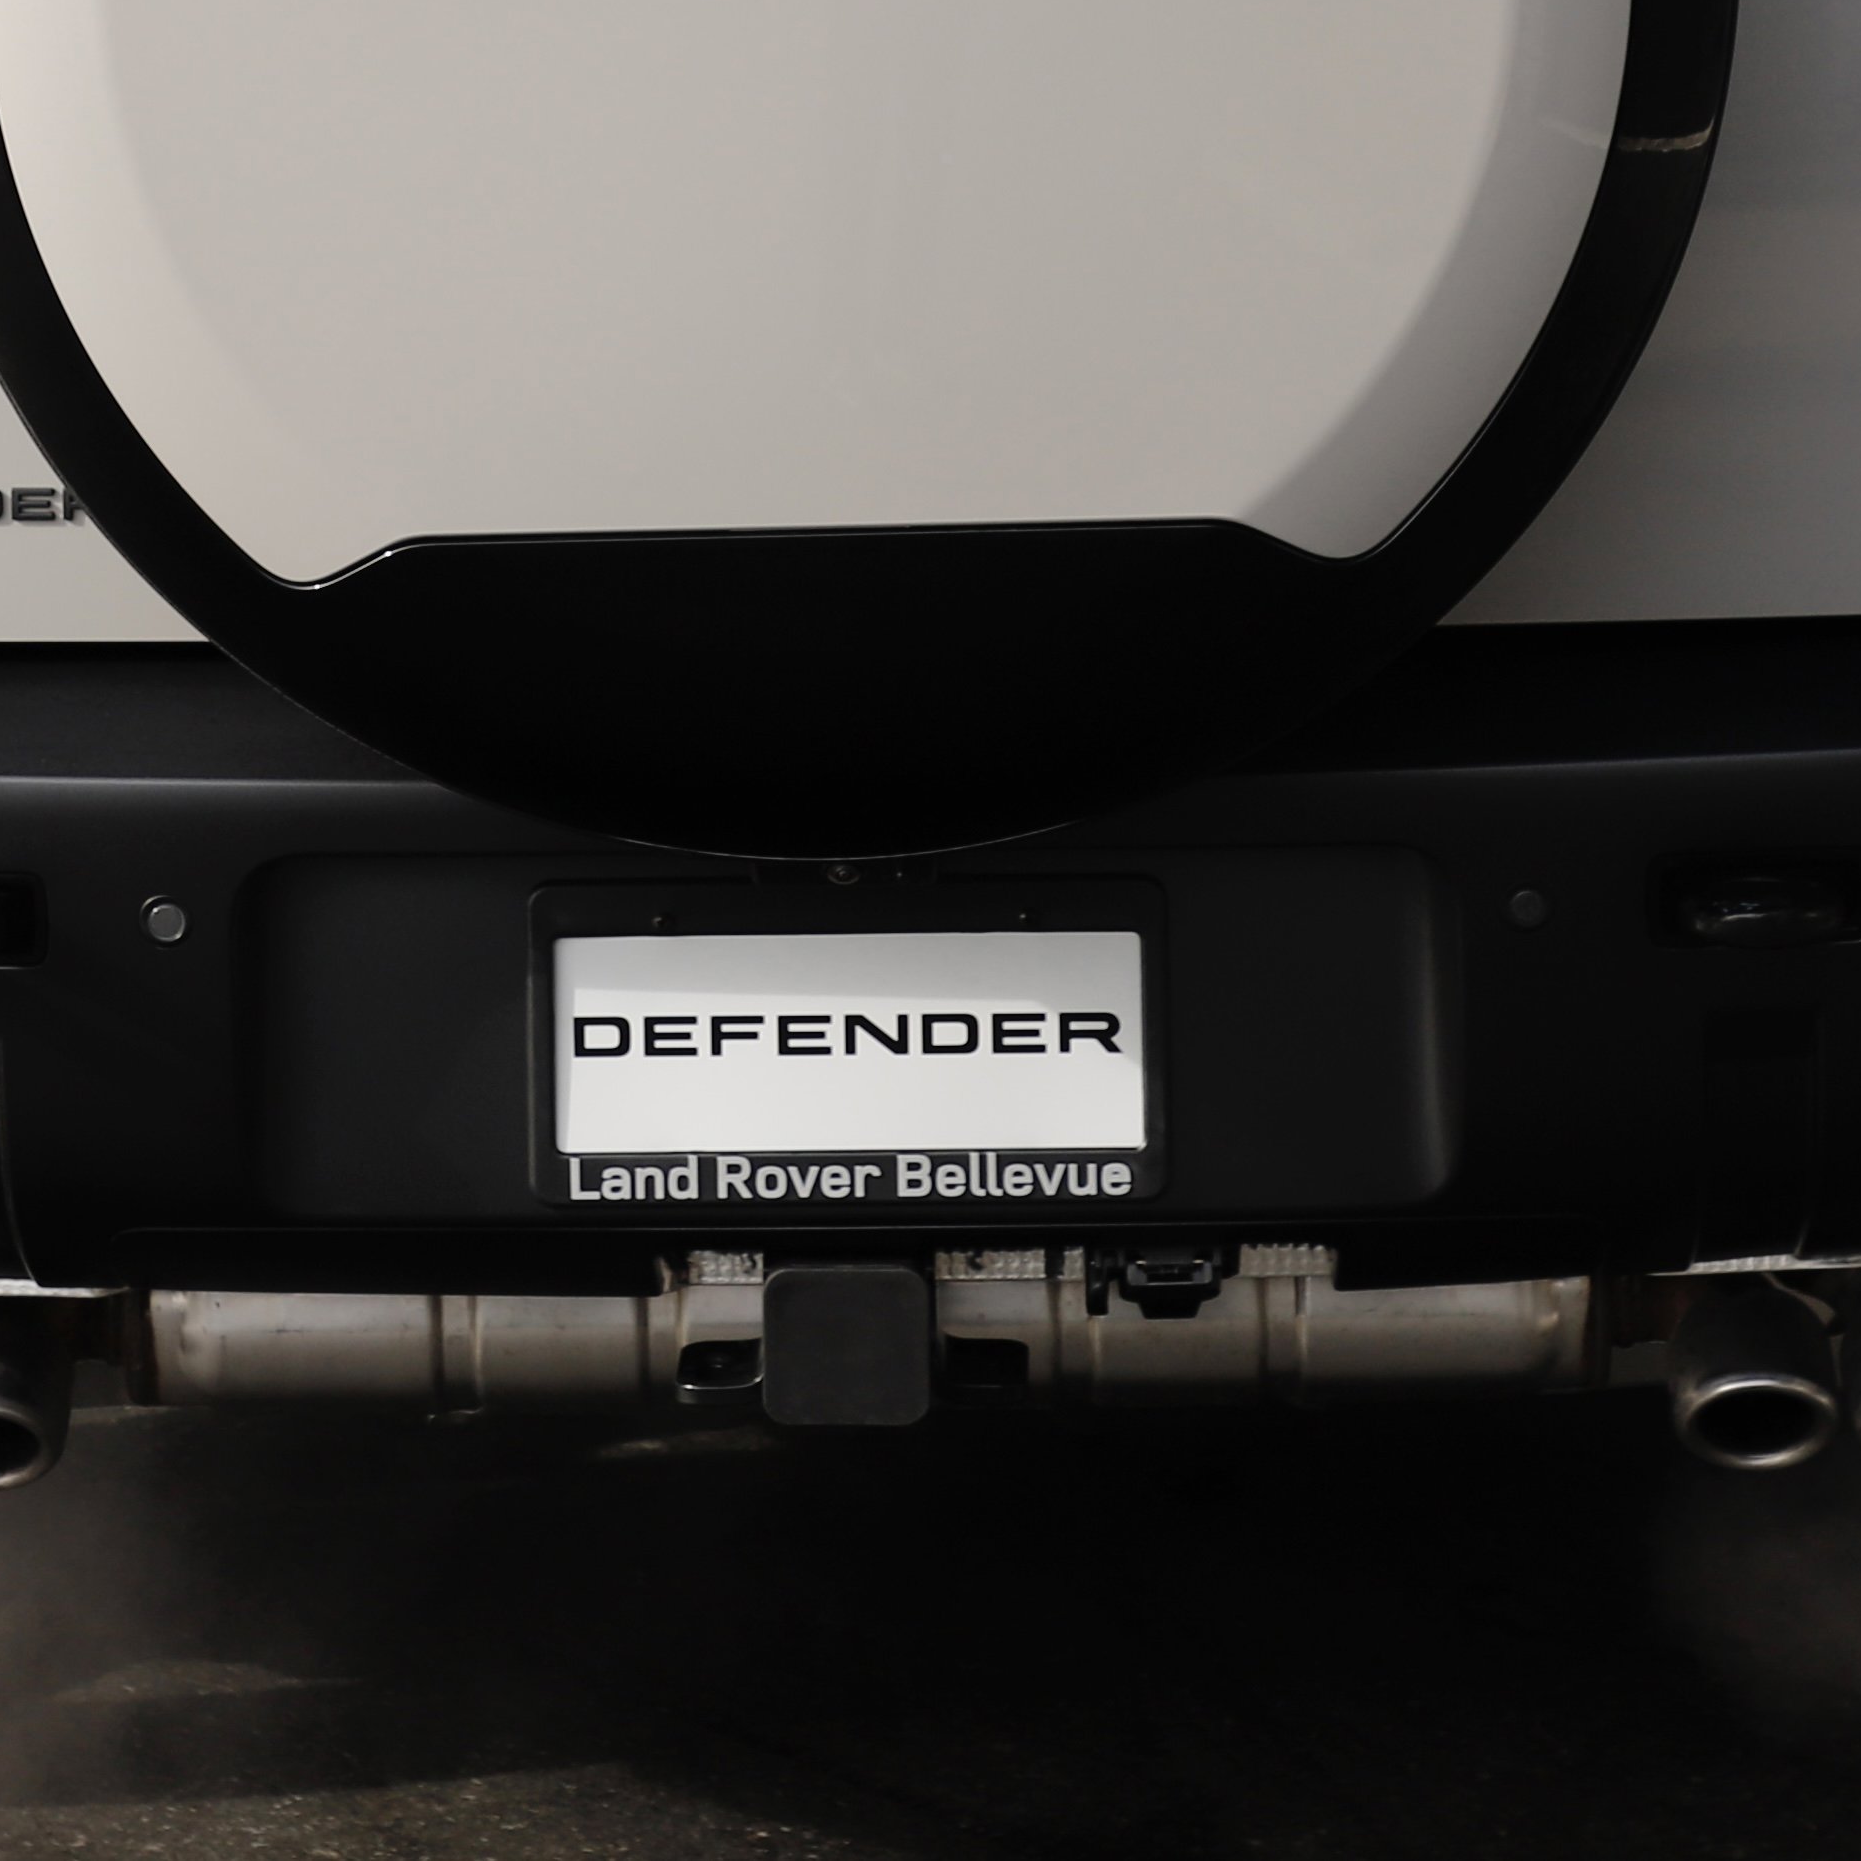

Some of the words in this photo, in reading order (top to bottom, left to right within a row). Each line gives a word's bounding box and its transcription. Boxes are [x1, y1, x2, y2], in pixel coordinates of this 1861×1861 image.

[573, 1012, 1123, 1057] DEFENDER
[569, 1155, 699, 1200] Land
[716, 1156, 881, 1199] Rover
[896, 1151, 1133, 1198] Bellevue
